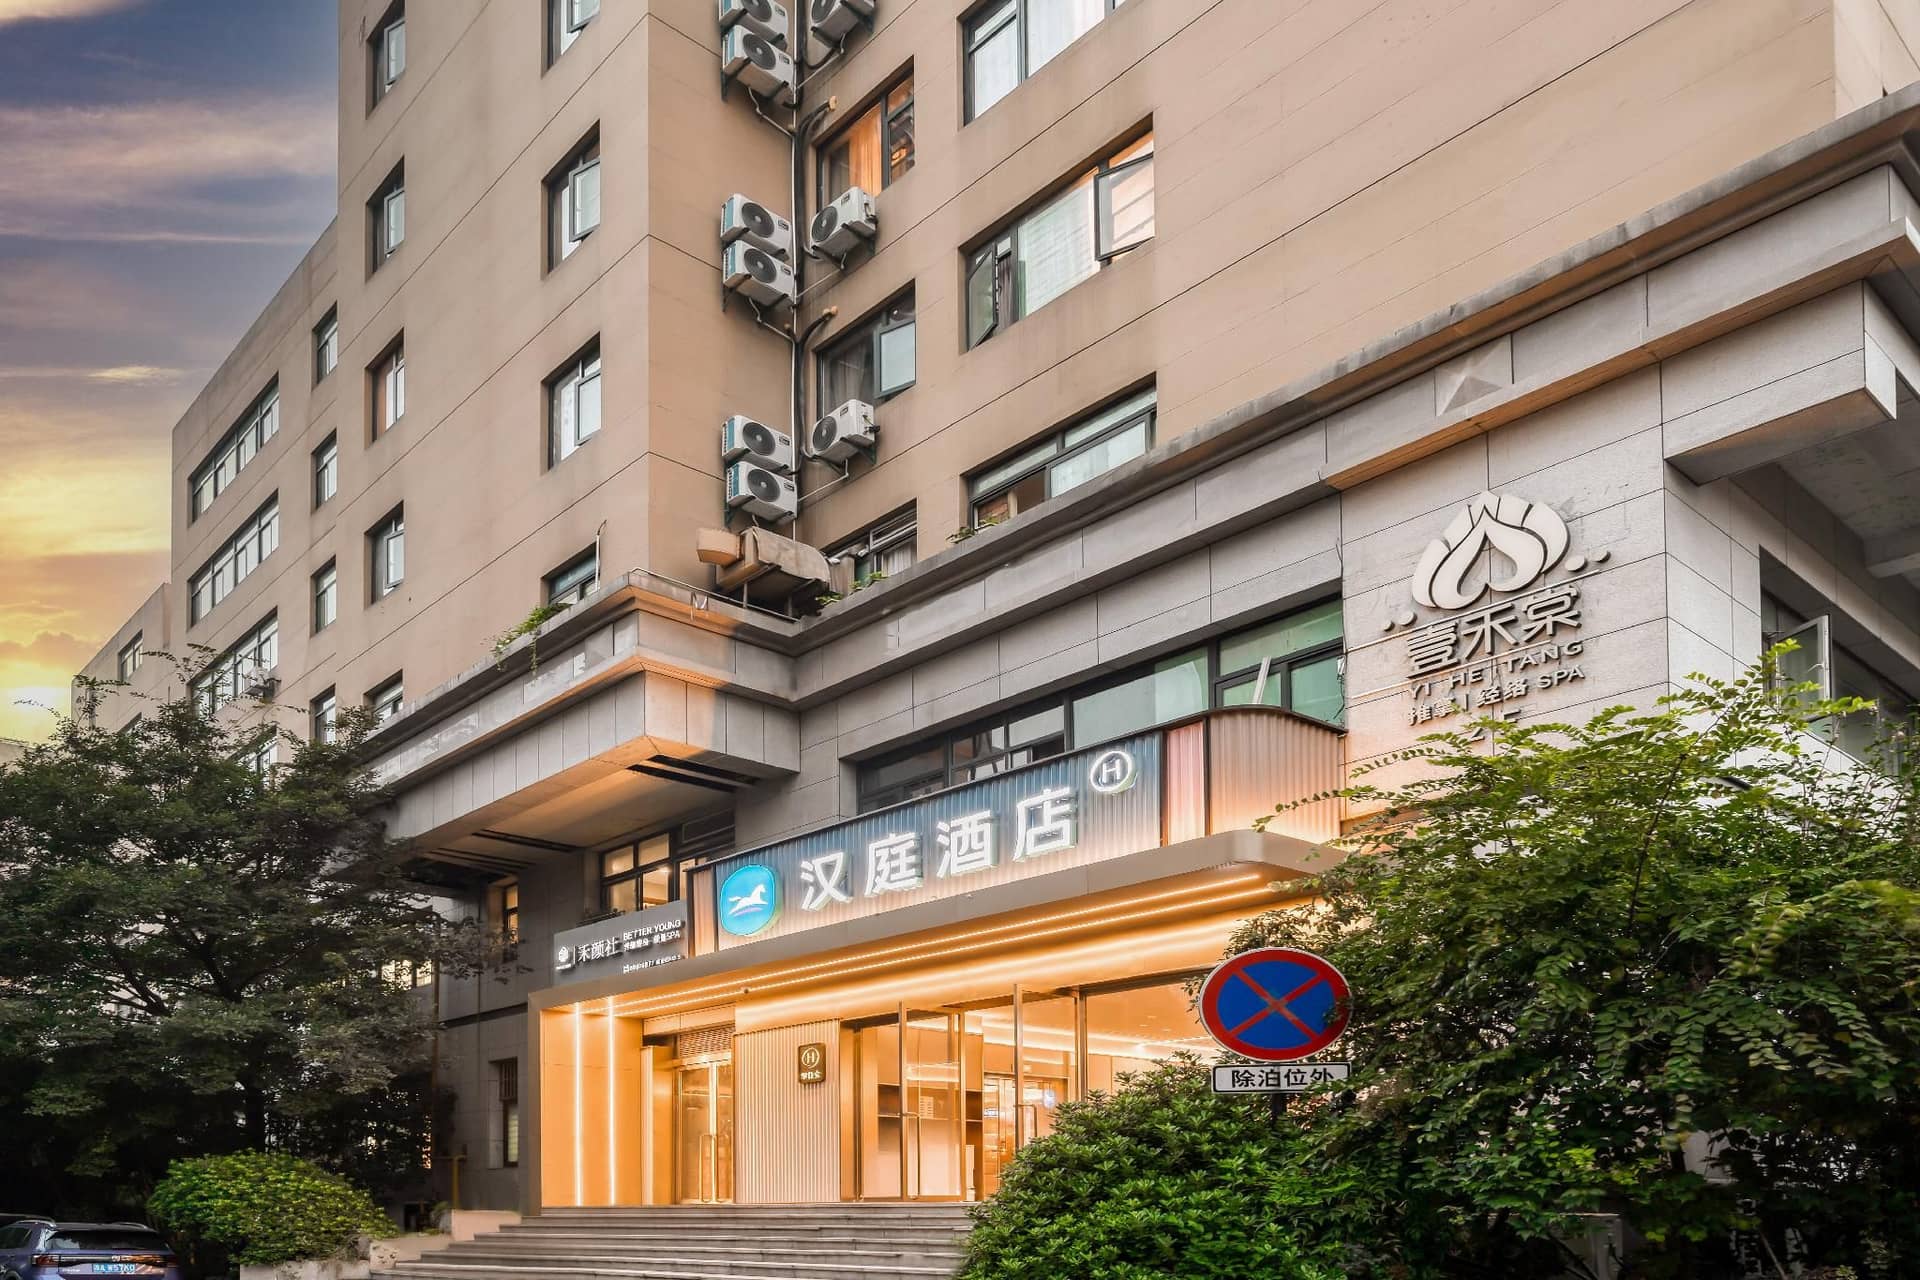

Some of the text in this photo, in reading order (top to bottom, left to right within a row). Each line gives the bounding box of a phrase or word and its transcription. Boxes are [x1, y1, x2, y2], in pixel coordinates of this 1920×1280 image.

[1407, 585, 1582, 679] 壹禾棠
[1409, 641, 1583, 699] YI HE TANG
[1477, 679, 1529, 708] 经络
[1537, 664, 1585, 690] SPA
[799, 787, 1080, 912] 汉庭酒店
[623, 919, 682, 941] BETTER YOUNG
[1231, 1067, 1335, 1089] 除泊位外
